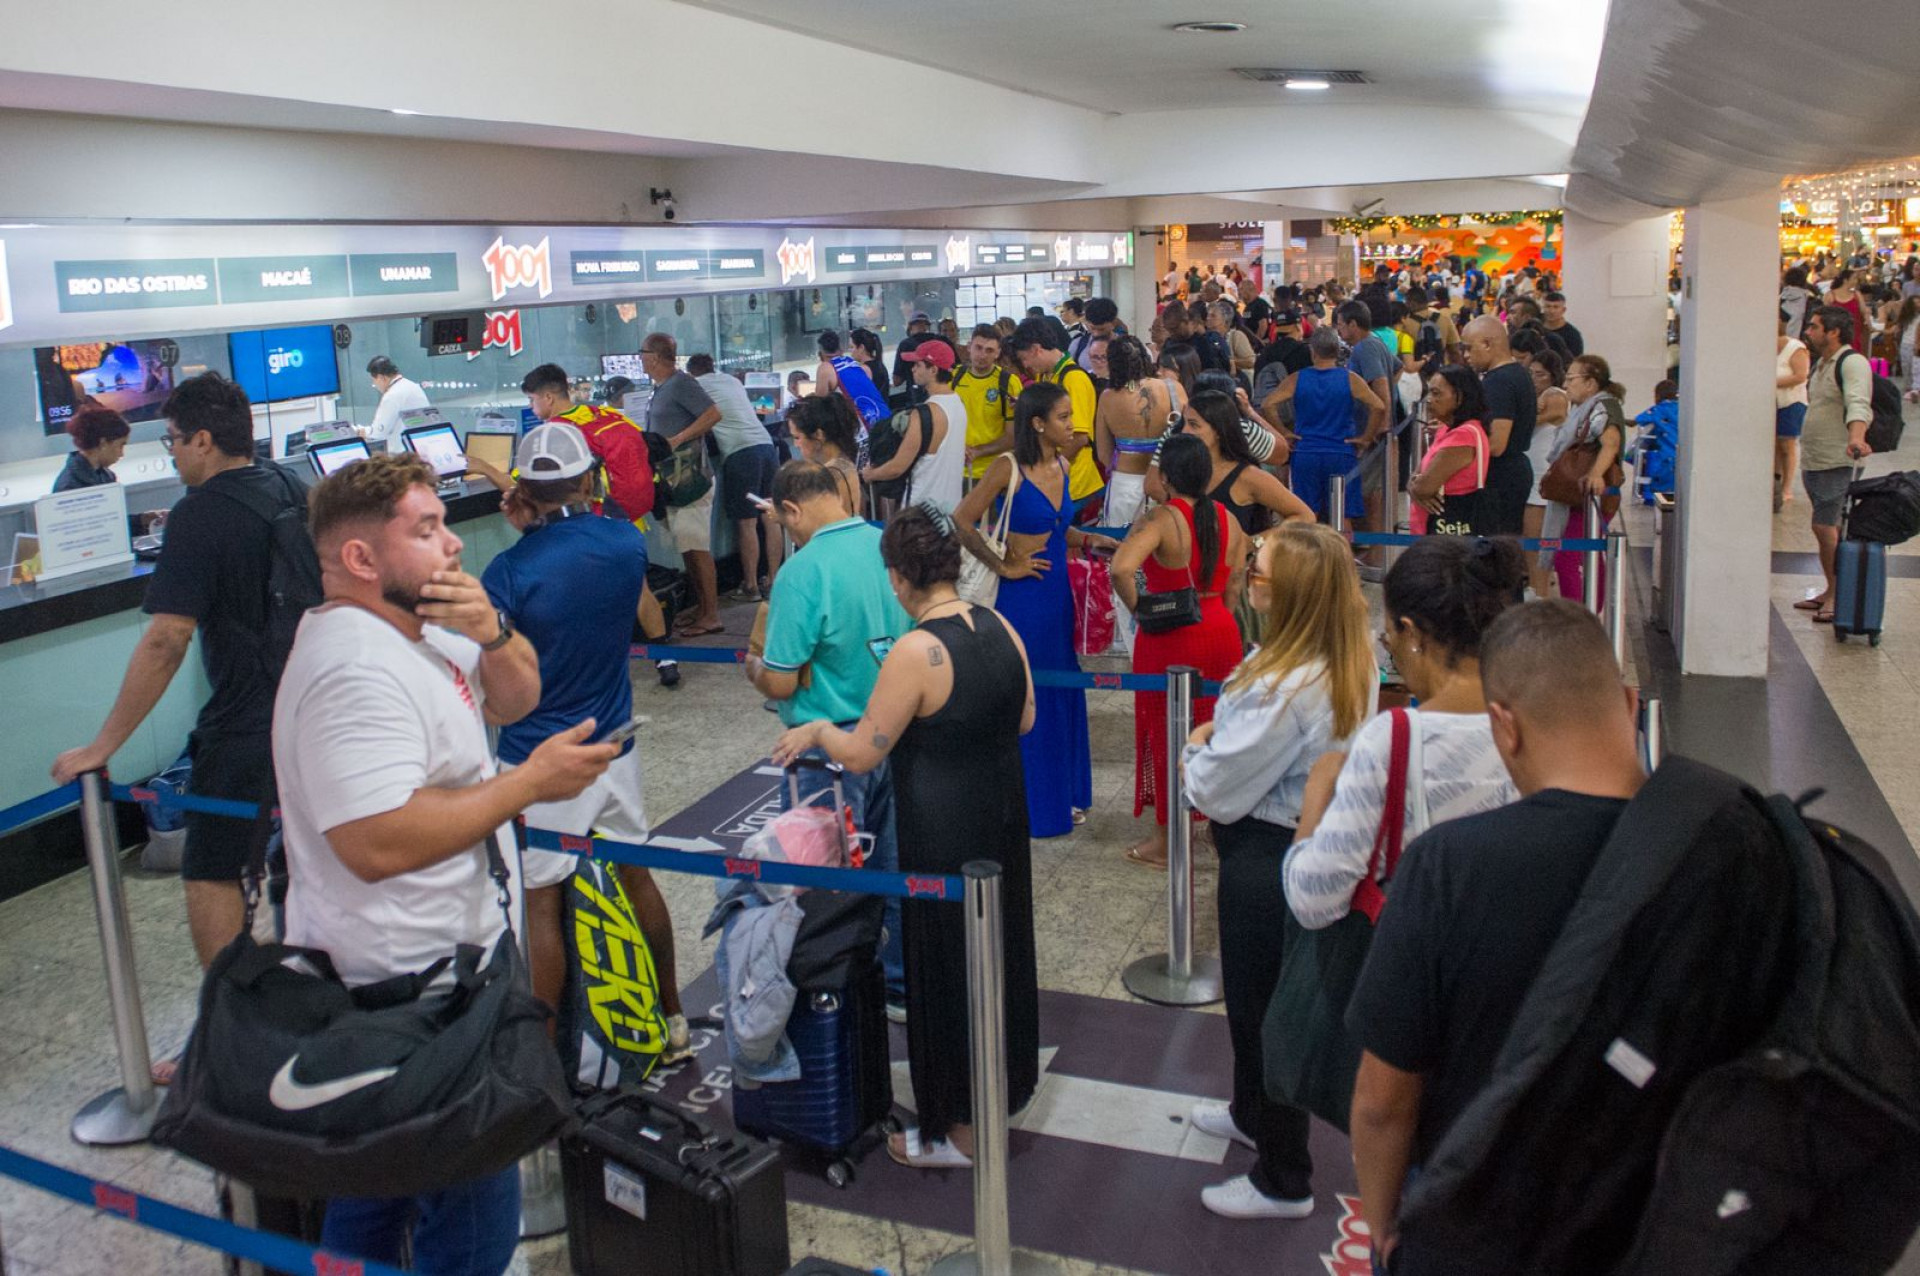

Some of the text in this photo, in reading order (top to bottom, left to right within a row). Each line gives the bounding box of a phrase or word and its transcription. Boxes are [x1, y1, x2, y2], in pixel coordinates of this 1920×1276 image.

[482, 236, 552, 301] 1001
[777, 236, 816, 285] 1001
[261, 267, 312, 287] MACAÉ
[380, 267, 432, 281] UNAMAR
[68, 275, 208, 295] RIO DAS OSTRAS
[336, 328, 350, 343] 08
[160, 345, 177, 362] 07
[438, 343, 462, 355] CAIXA
[269, 347, 304, 374] giro
[906, 876, 945, 899] 1001
